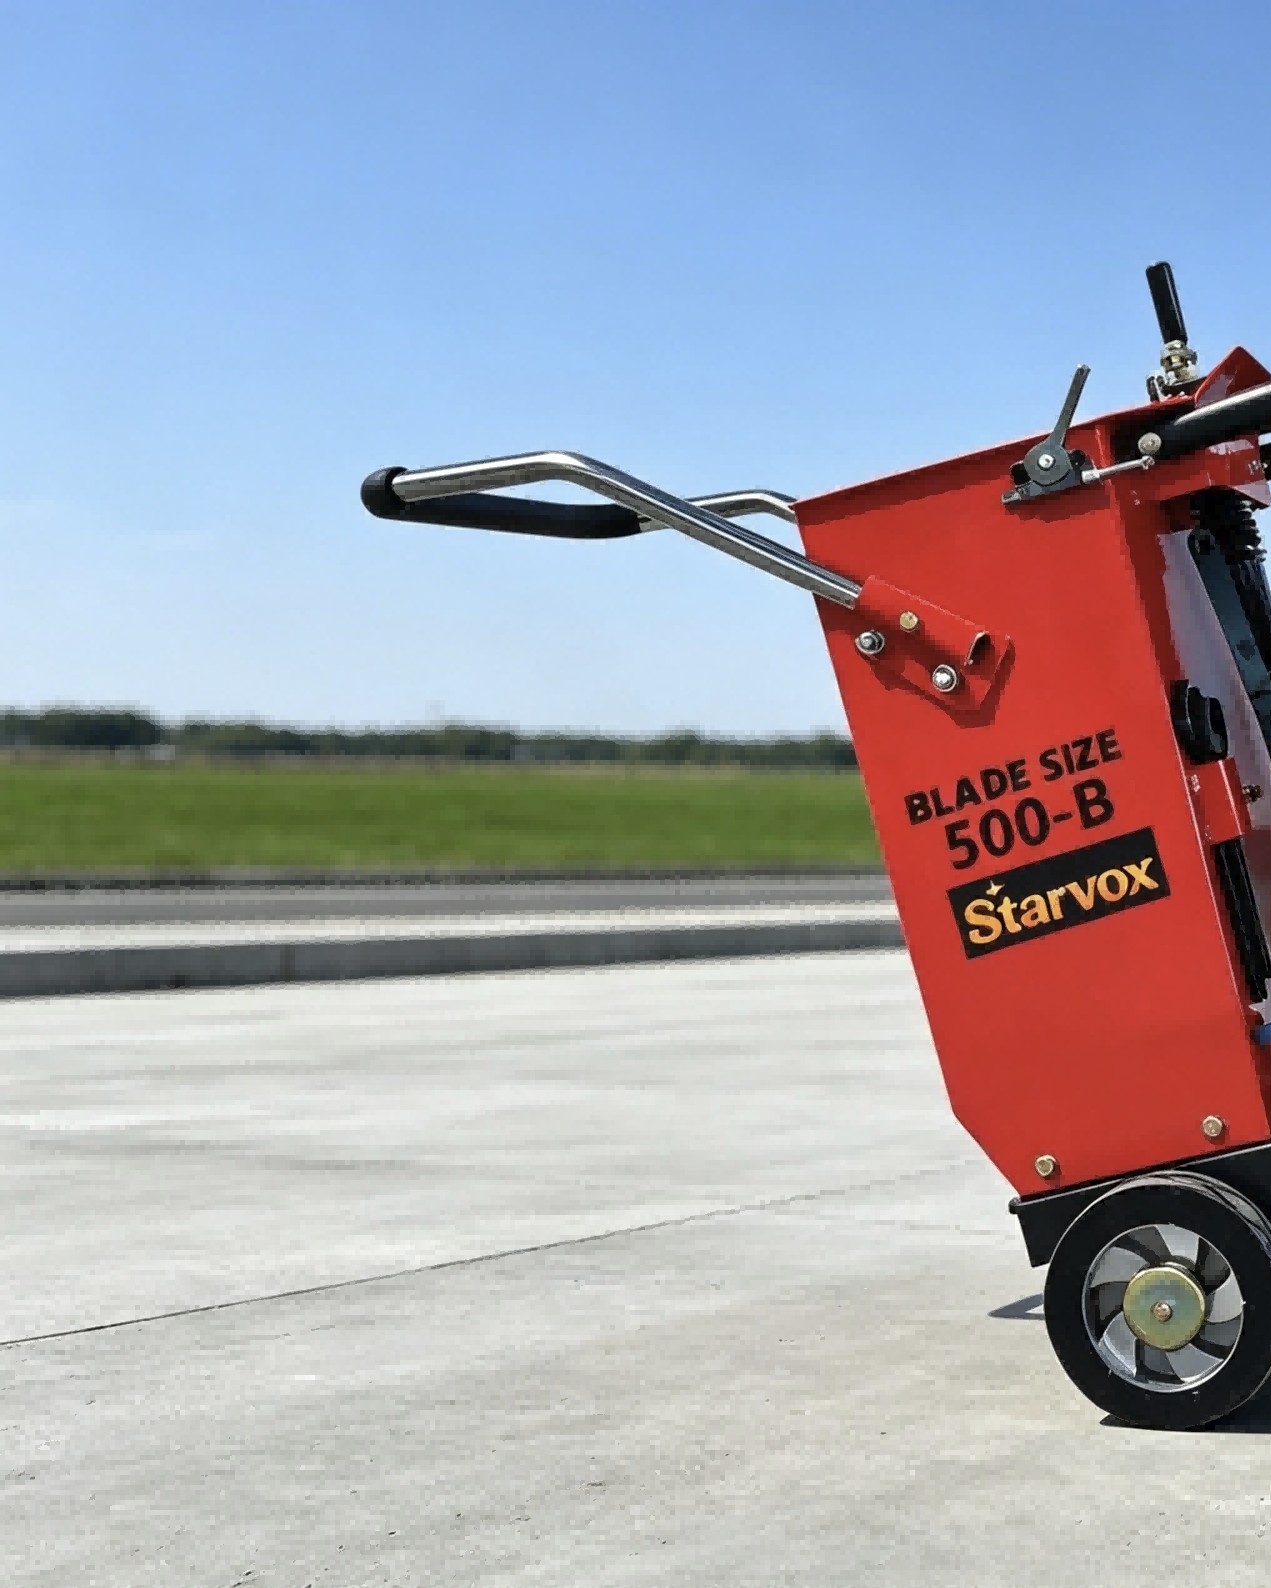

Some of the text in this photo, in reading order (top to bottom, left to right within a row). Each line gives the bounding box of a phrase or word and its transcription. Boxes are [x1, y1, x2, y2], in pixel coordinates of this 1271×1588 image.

[904, 728, 1122, 825] BLADE SIZE
[944, 778, 1115, 871] 500-B
[964, 857, 1159, 945] Starvox
